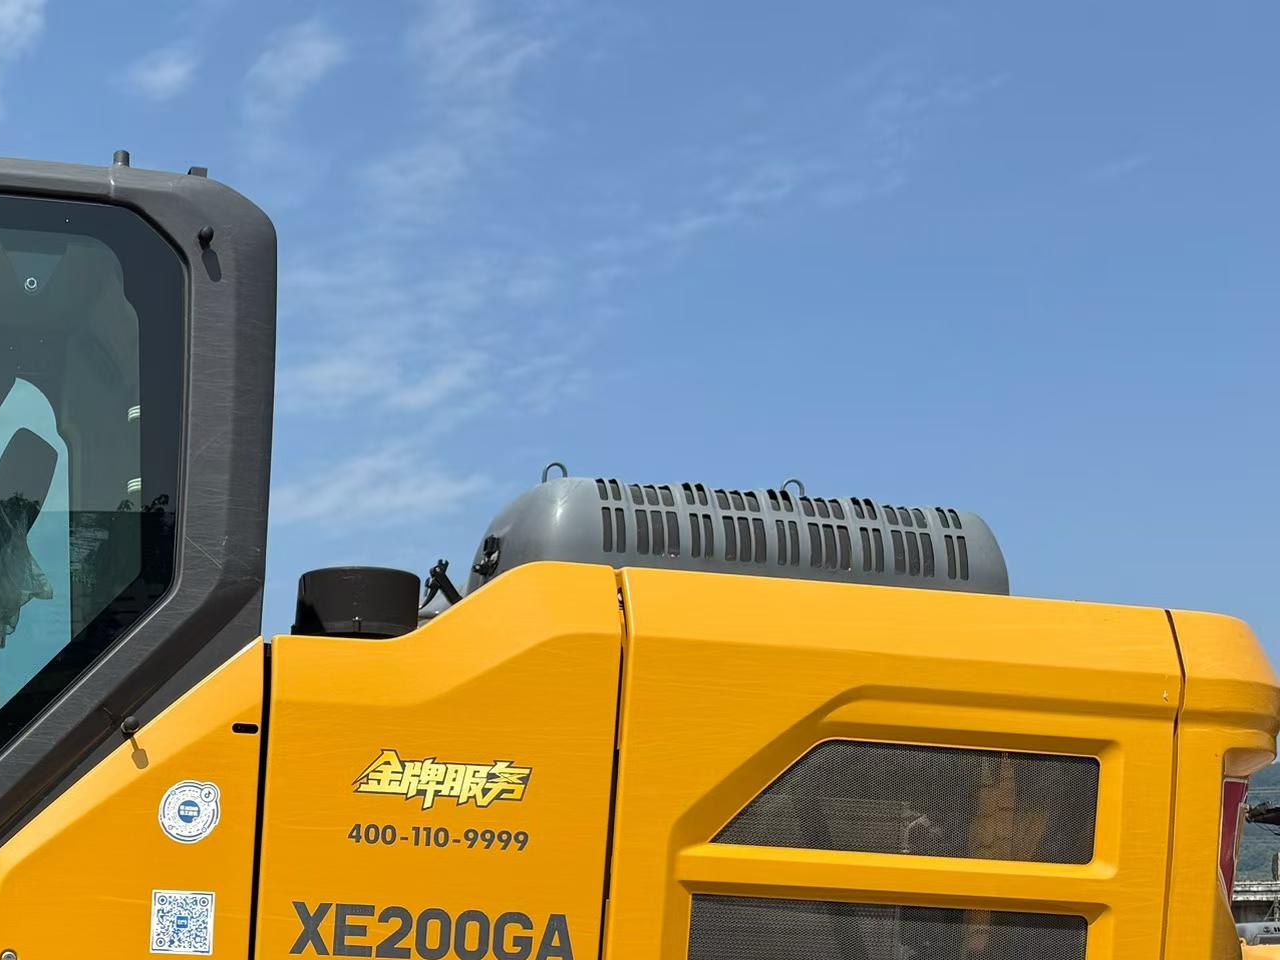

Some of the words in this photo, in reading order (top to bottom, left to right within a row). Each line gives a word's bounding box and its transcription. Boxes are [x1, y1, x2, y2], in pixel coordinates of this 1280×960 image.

[352, 749, 532, 811] 金牌服务
[348, 823, 530, 852] 400-110-9999
